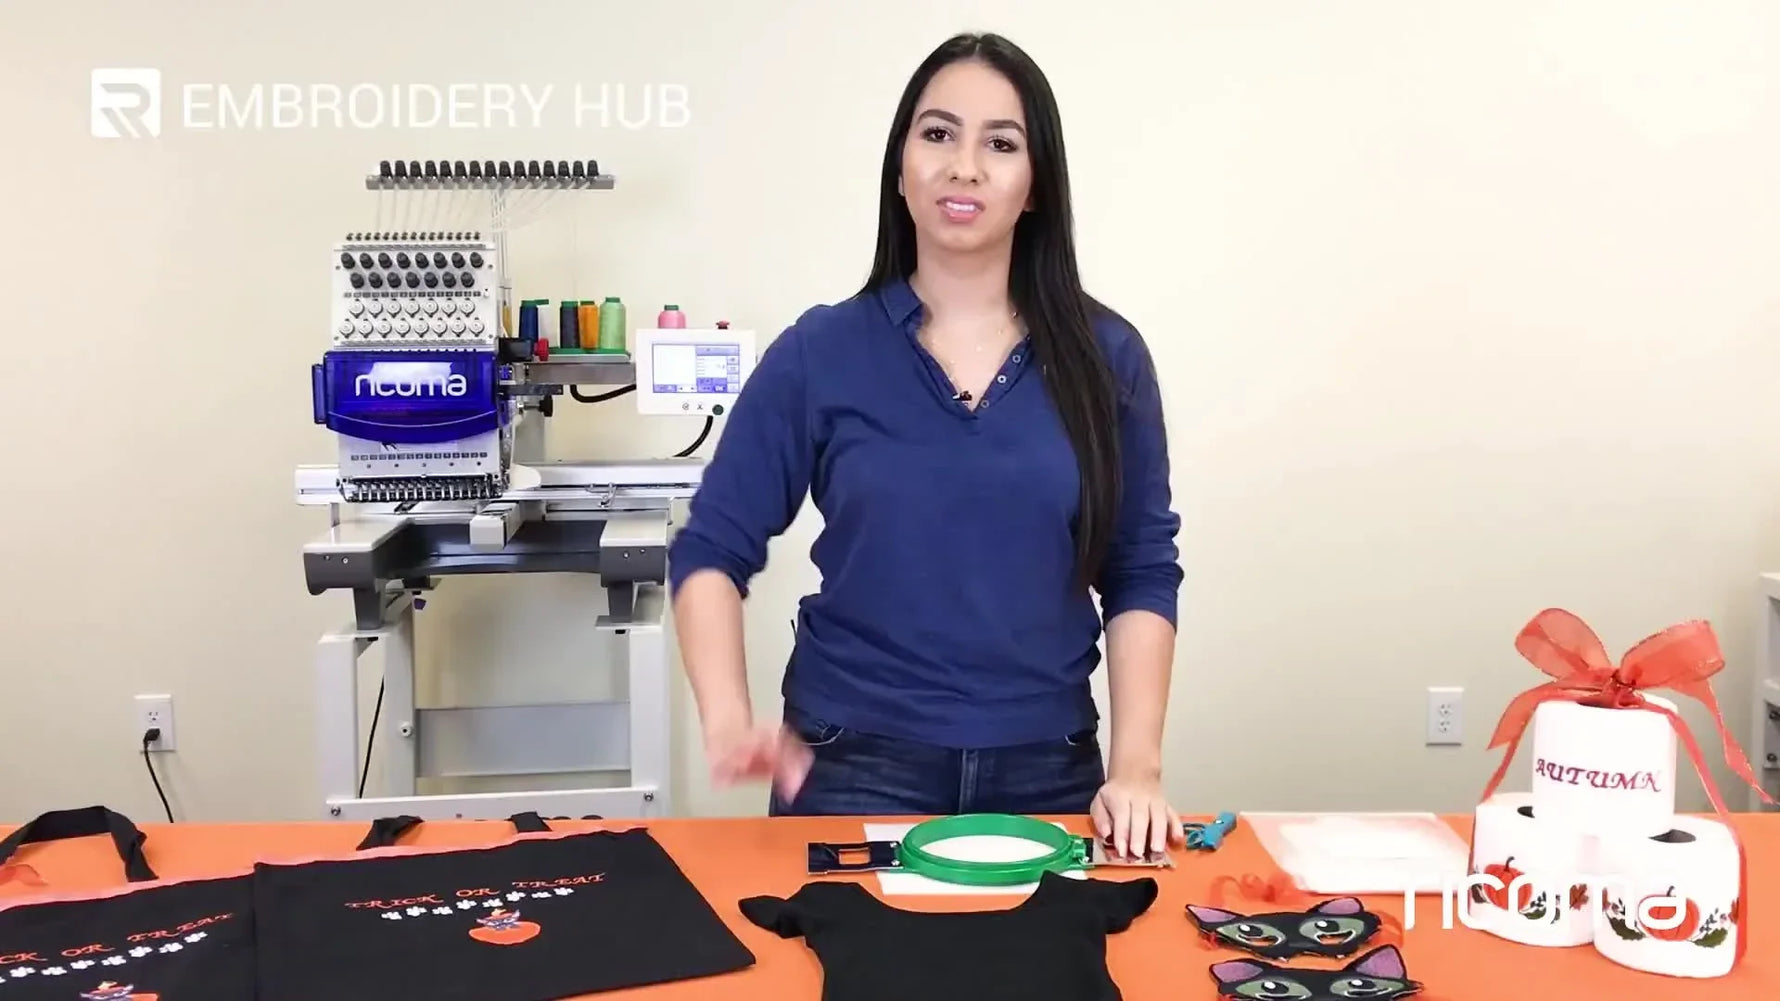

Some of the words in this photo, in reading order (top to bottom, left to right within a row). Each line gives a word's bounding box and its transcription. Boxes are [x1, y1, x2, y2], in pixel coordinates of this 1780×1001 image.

[355, 373, 467, 397] ricoma
[1534, 758, 1662, 793] AUTUMN
[344, 894, 445, 909] TRICK
[455, 887, 500, 898] OR
[511, 872, 606, 889] TREAT
[61, 944, 116, 957] OR
